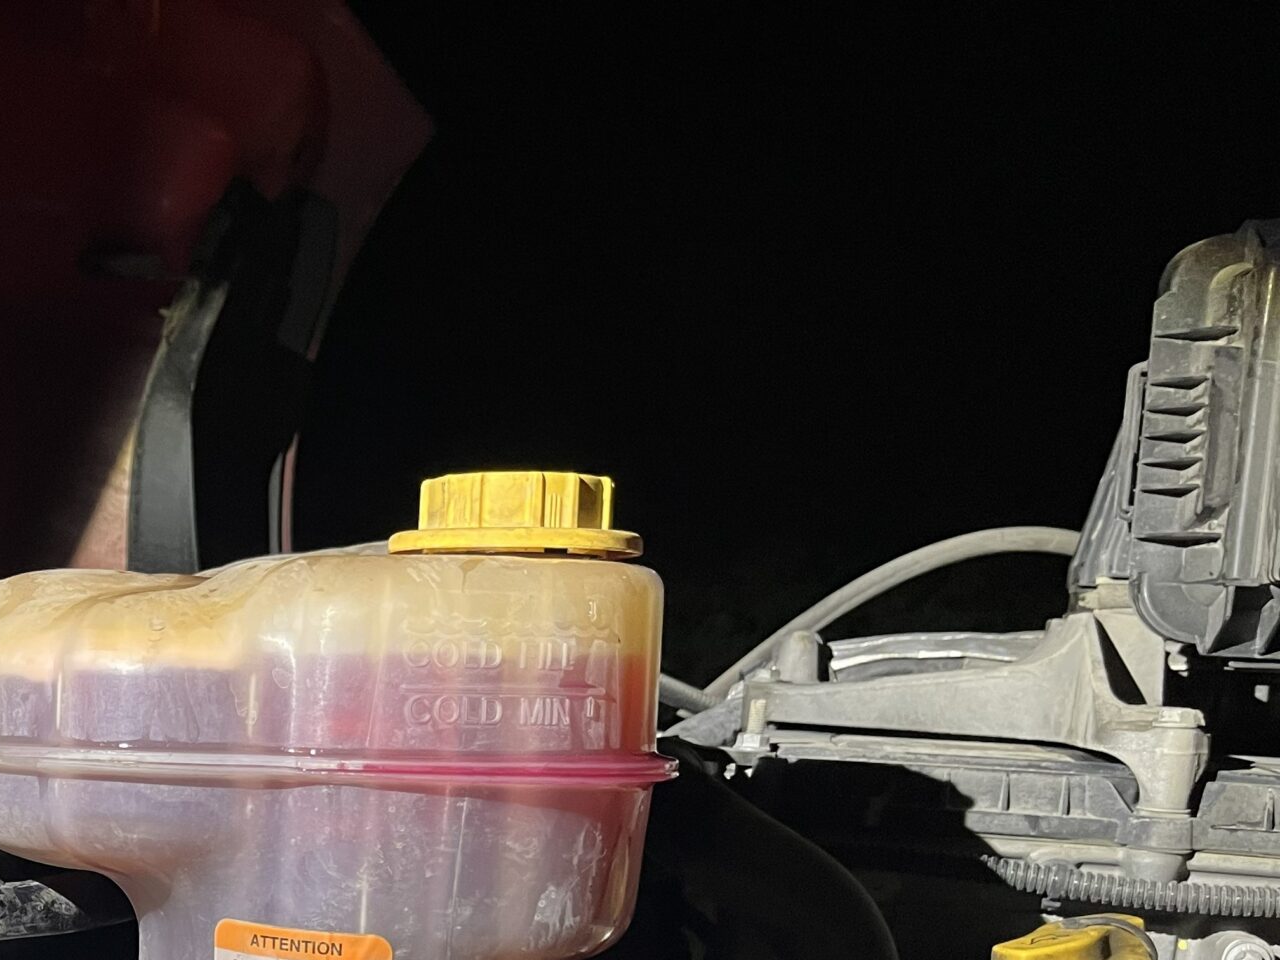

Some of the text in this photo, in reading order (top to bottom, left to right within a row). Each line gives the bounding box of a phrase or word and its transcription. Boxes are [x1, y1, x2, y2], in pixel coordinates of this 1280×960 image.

[403, 637, 502, 670] COLD
[404, 696, 570, 727] COLD MIN
[251, 934, 342, 956] ATTENTION
